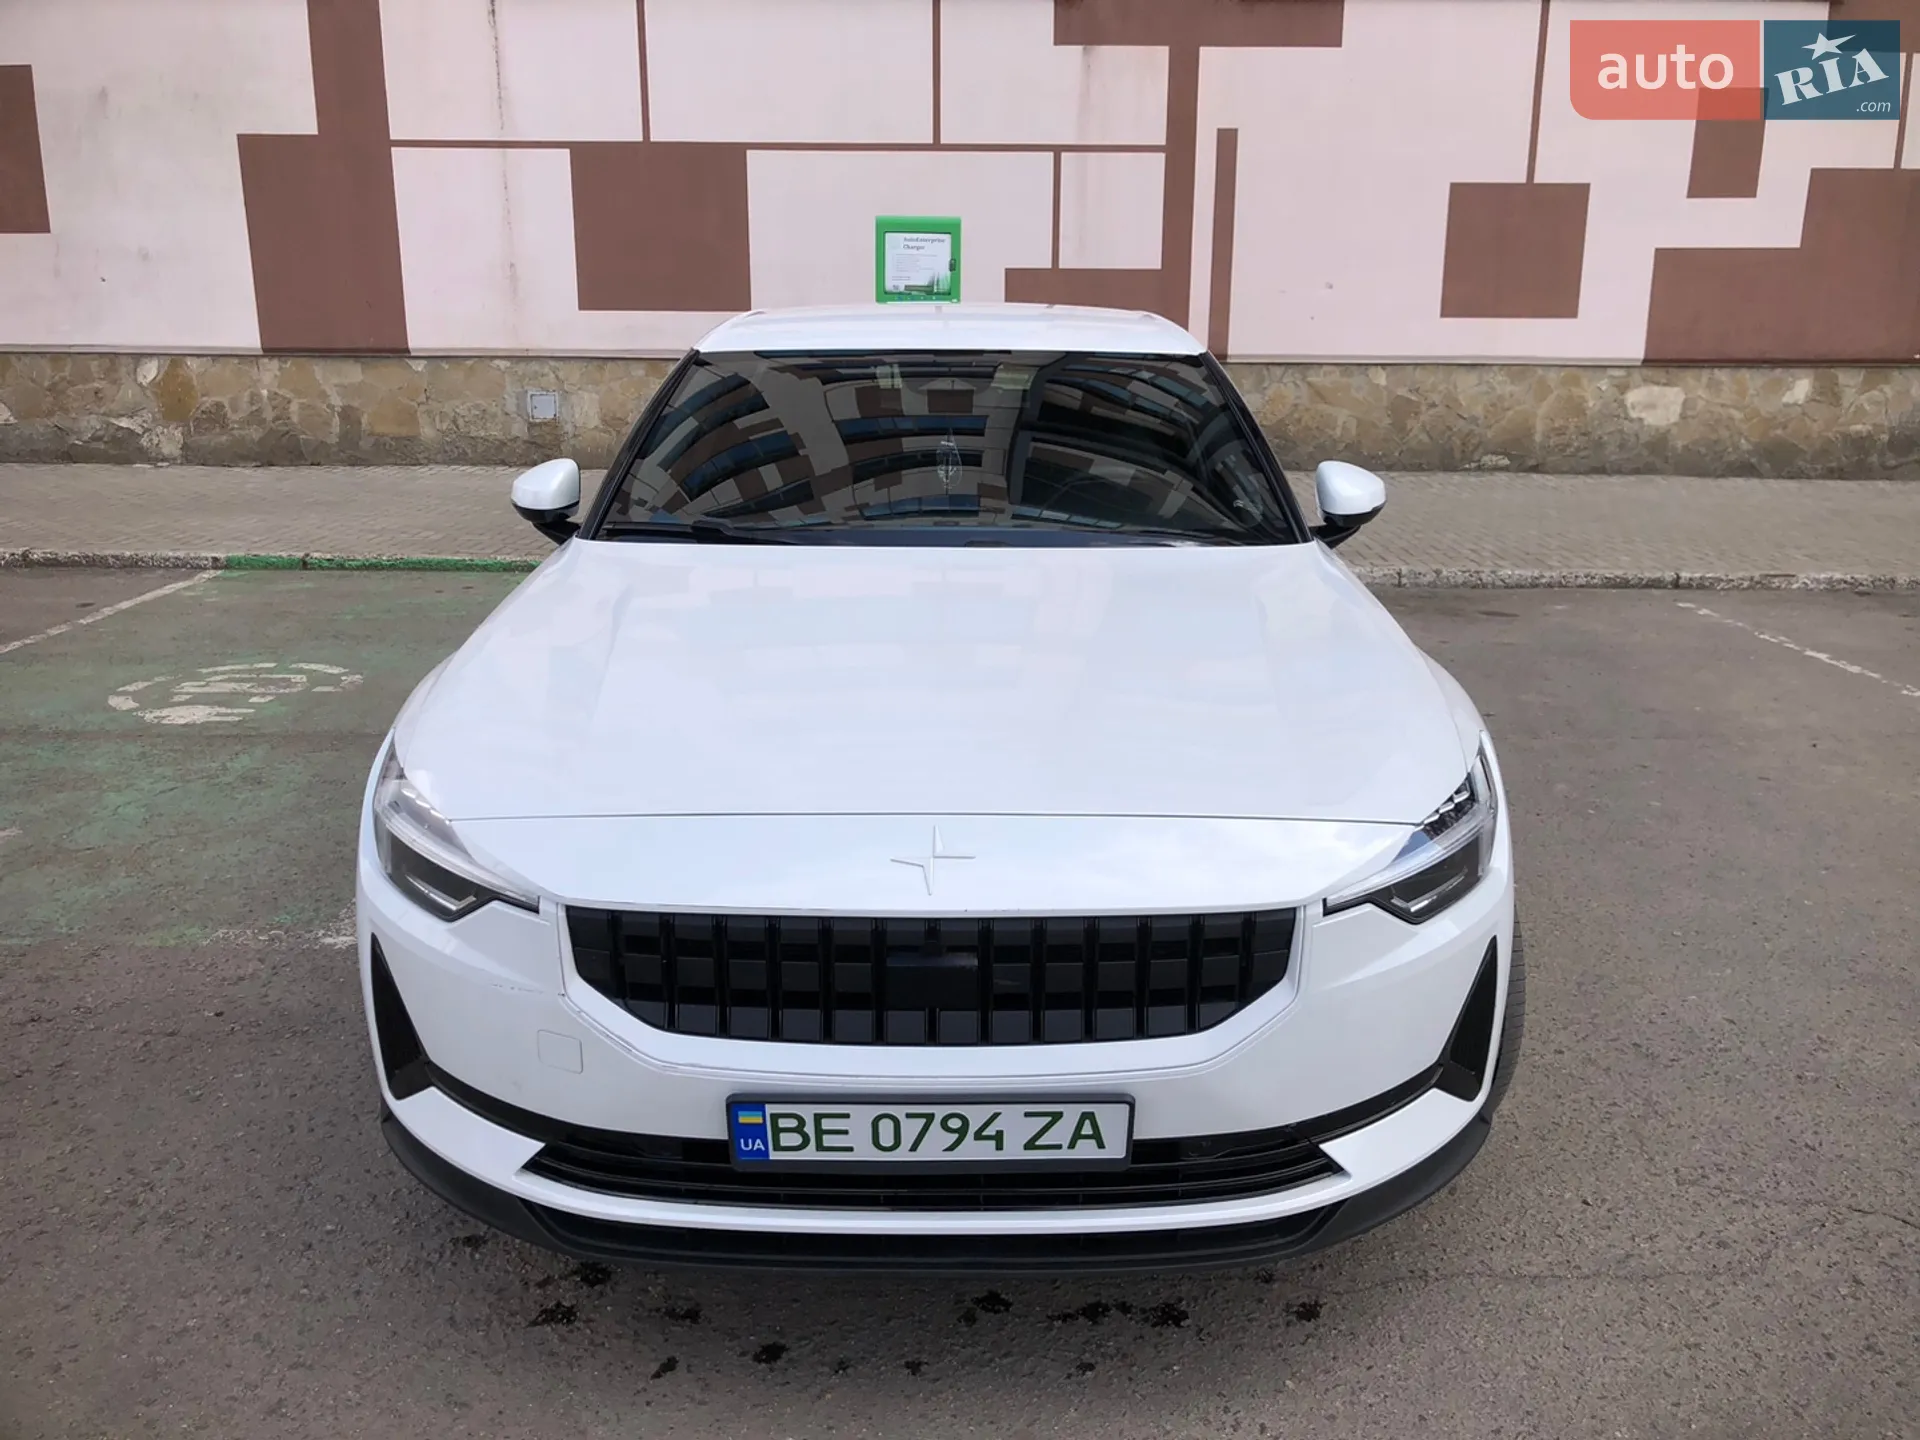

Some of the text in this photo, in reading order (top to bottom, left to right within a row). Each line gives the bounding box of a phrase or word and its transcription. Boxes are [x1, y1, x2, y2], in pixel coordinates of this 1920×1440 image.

[740, 1137, 766, 1152] UA
[769, 1110, 1107, 1153] BE 0794 ZA
